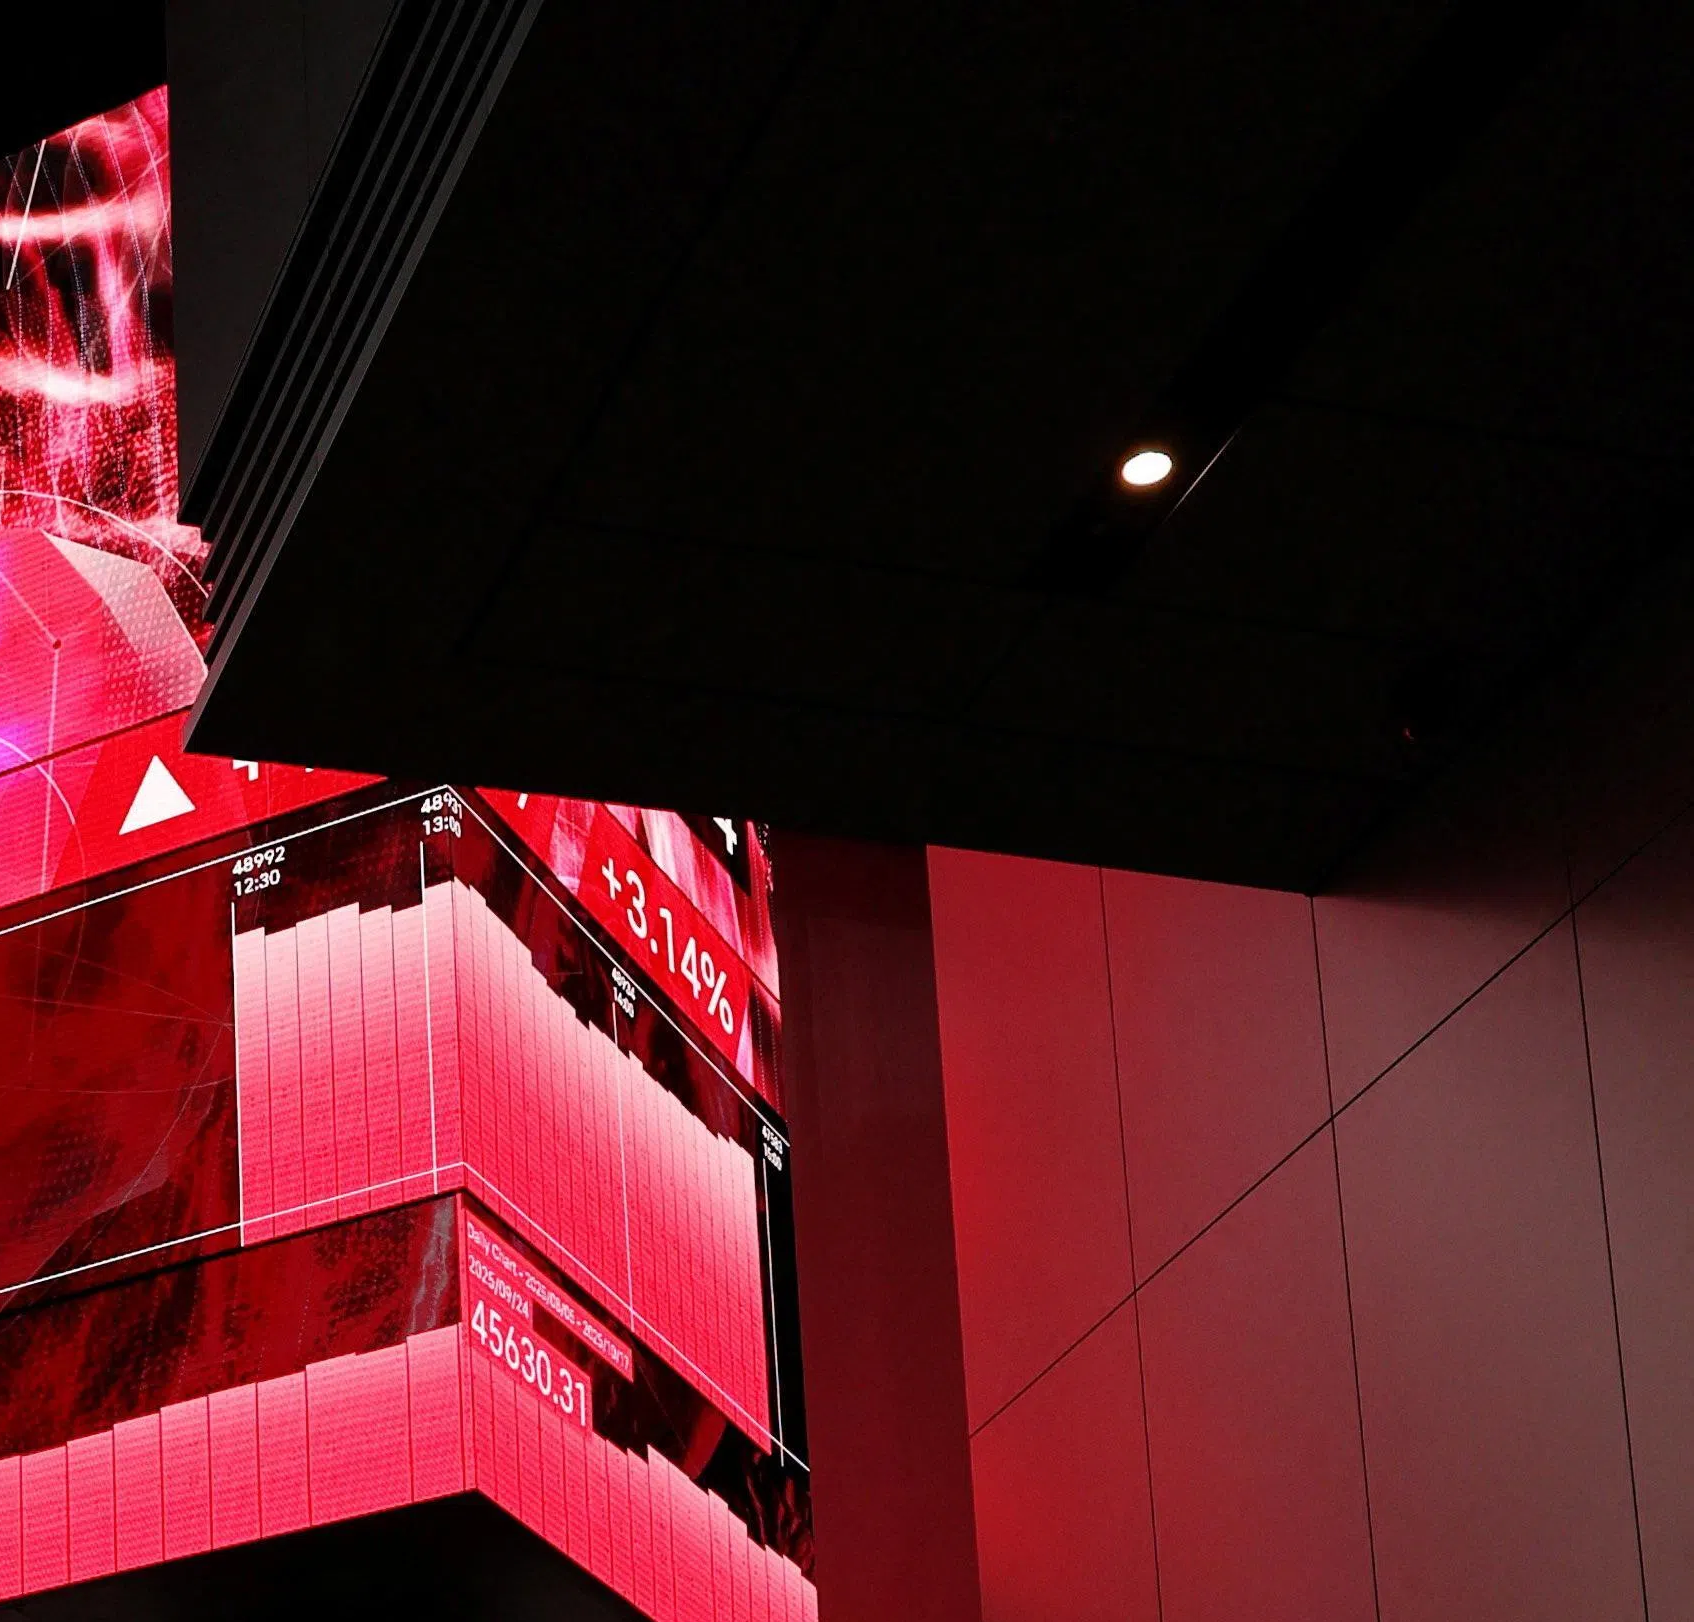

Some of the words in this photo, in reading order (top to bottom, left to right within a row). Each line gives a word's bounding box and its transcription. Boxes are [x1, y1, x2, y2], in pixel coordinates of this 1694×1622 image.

[420, 791, 462, 819] 48931
[422, 815, 461, 838] 13:00
[232, 845, 286, 876] 48992
[234, 867, 281, 898] 12:30
[601, 857, 734, 1034] +3.14%
[468, 1254, 530, 1320] 2025/09/24
[471, 1300, 586, 1427] 45630.31
